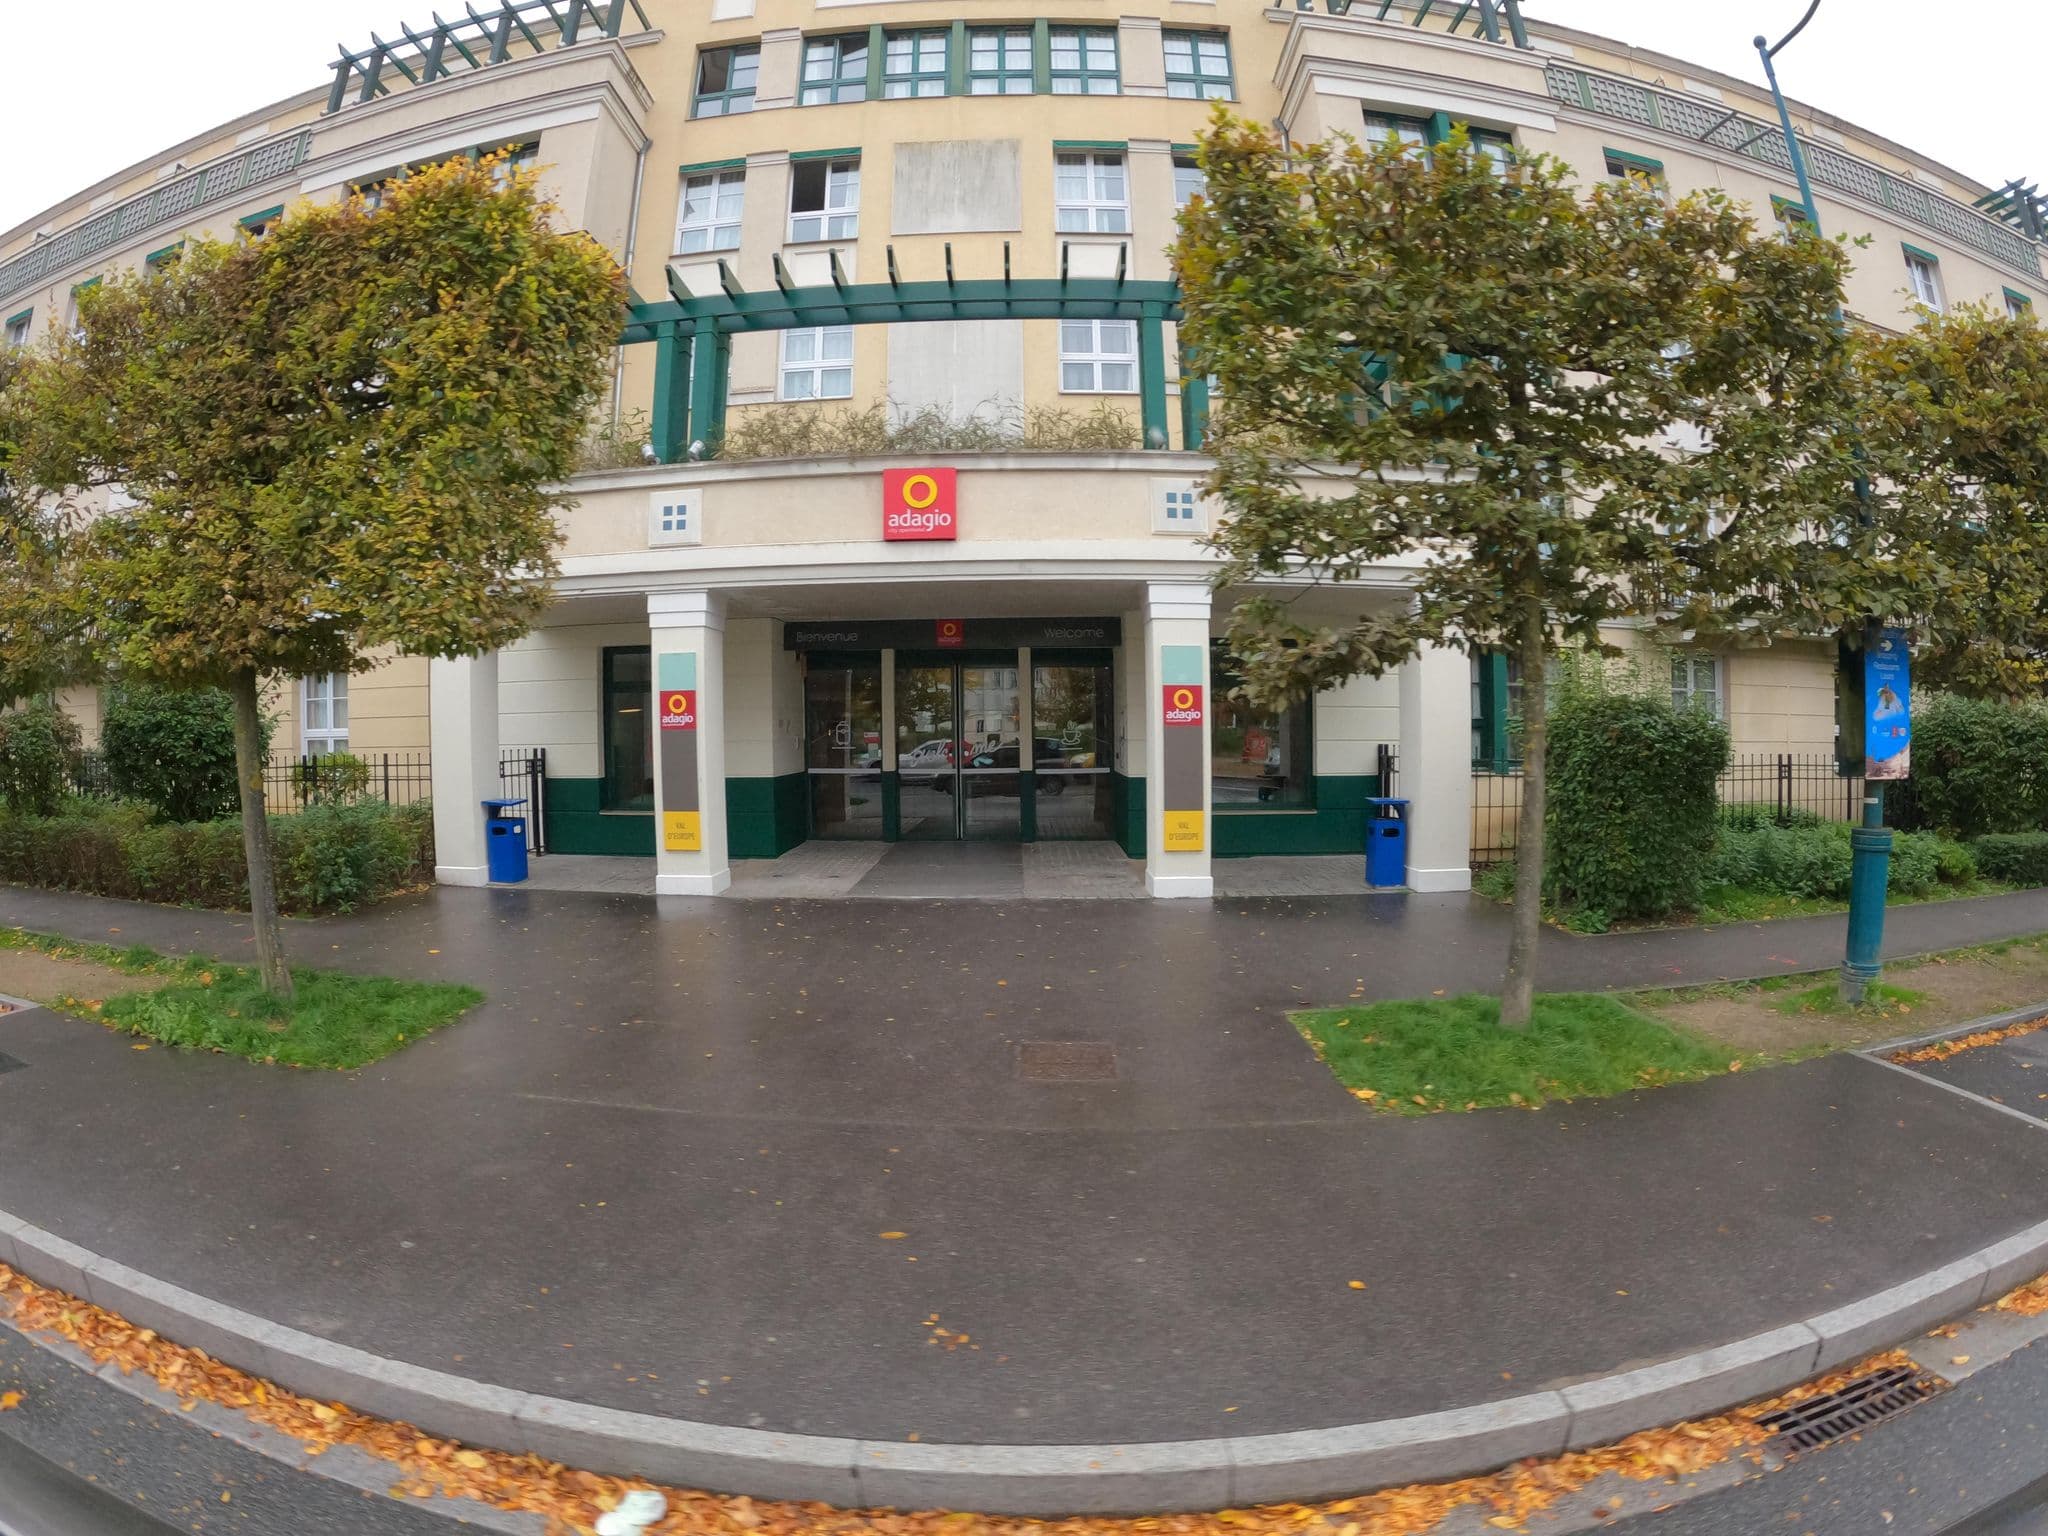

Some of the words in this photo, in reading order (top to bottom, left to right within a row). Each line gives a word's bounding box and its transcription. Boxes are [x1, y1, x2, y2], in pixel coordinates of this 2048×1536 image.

[888, 508, 952, 532] adagio
[796, 631, 858, 642] Bienvenue
[662, 712, 694, 726] adagio
[1166, 708, 1201, 722] adagio
